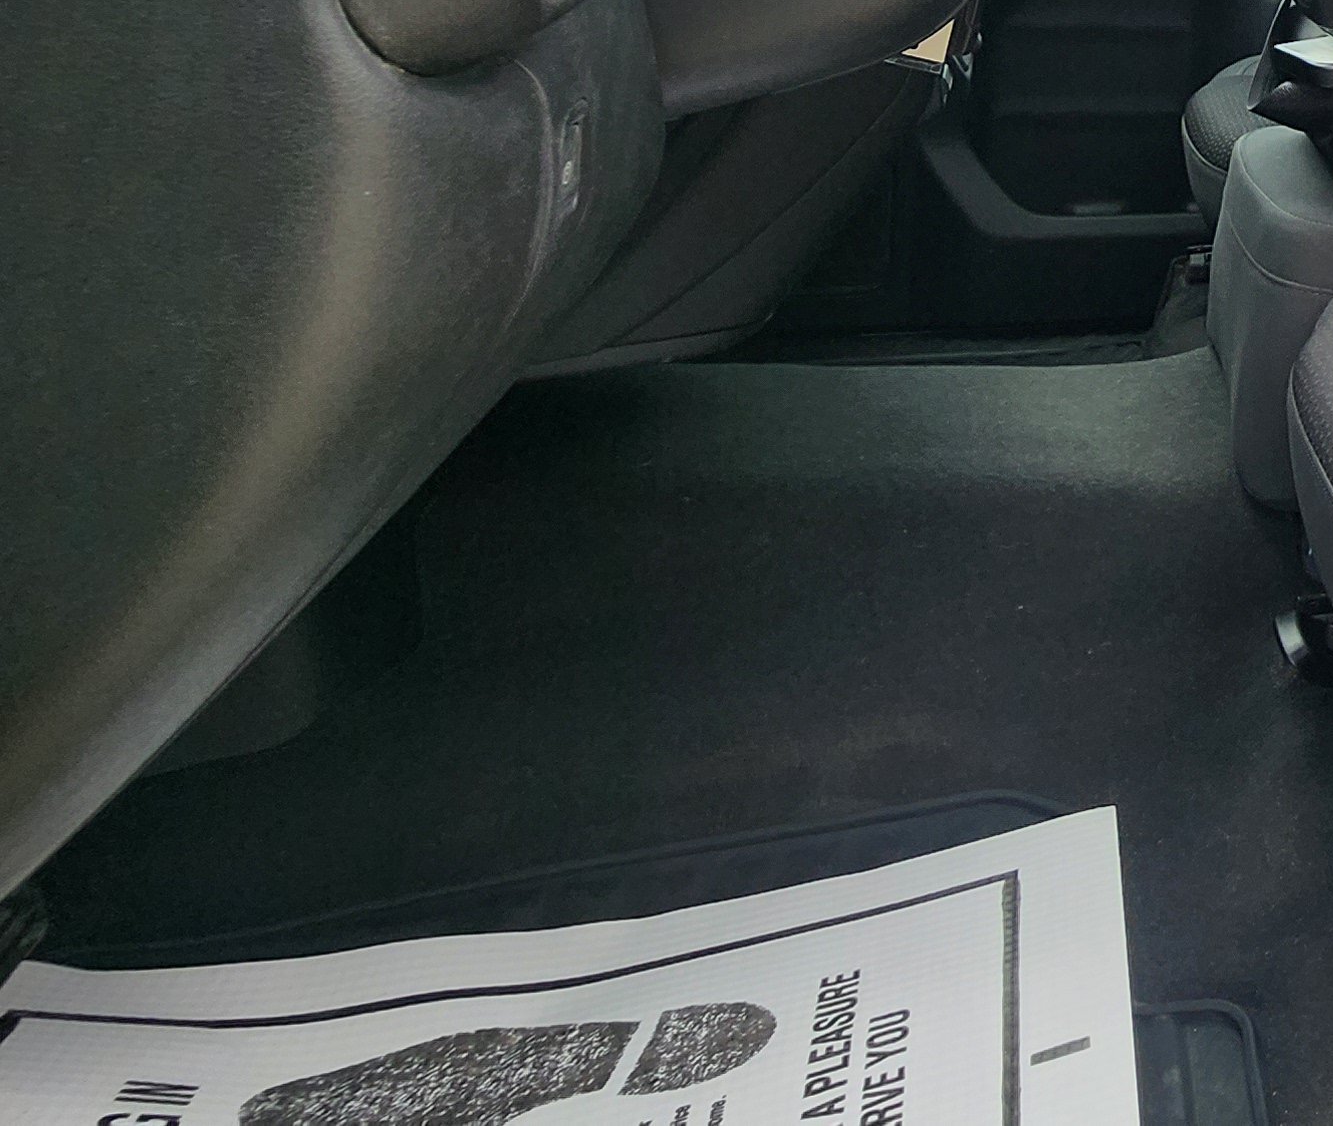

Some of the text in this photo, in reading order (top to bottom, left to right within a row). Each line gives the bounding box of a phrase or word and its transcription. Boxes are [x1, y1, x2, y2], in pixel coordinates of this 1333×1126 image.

[112, 1080, 200, 1106] IN
[800, 969, 862, 1120] A PLEASURE
[860, 1009, 911, 1126] RVE YOU
